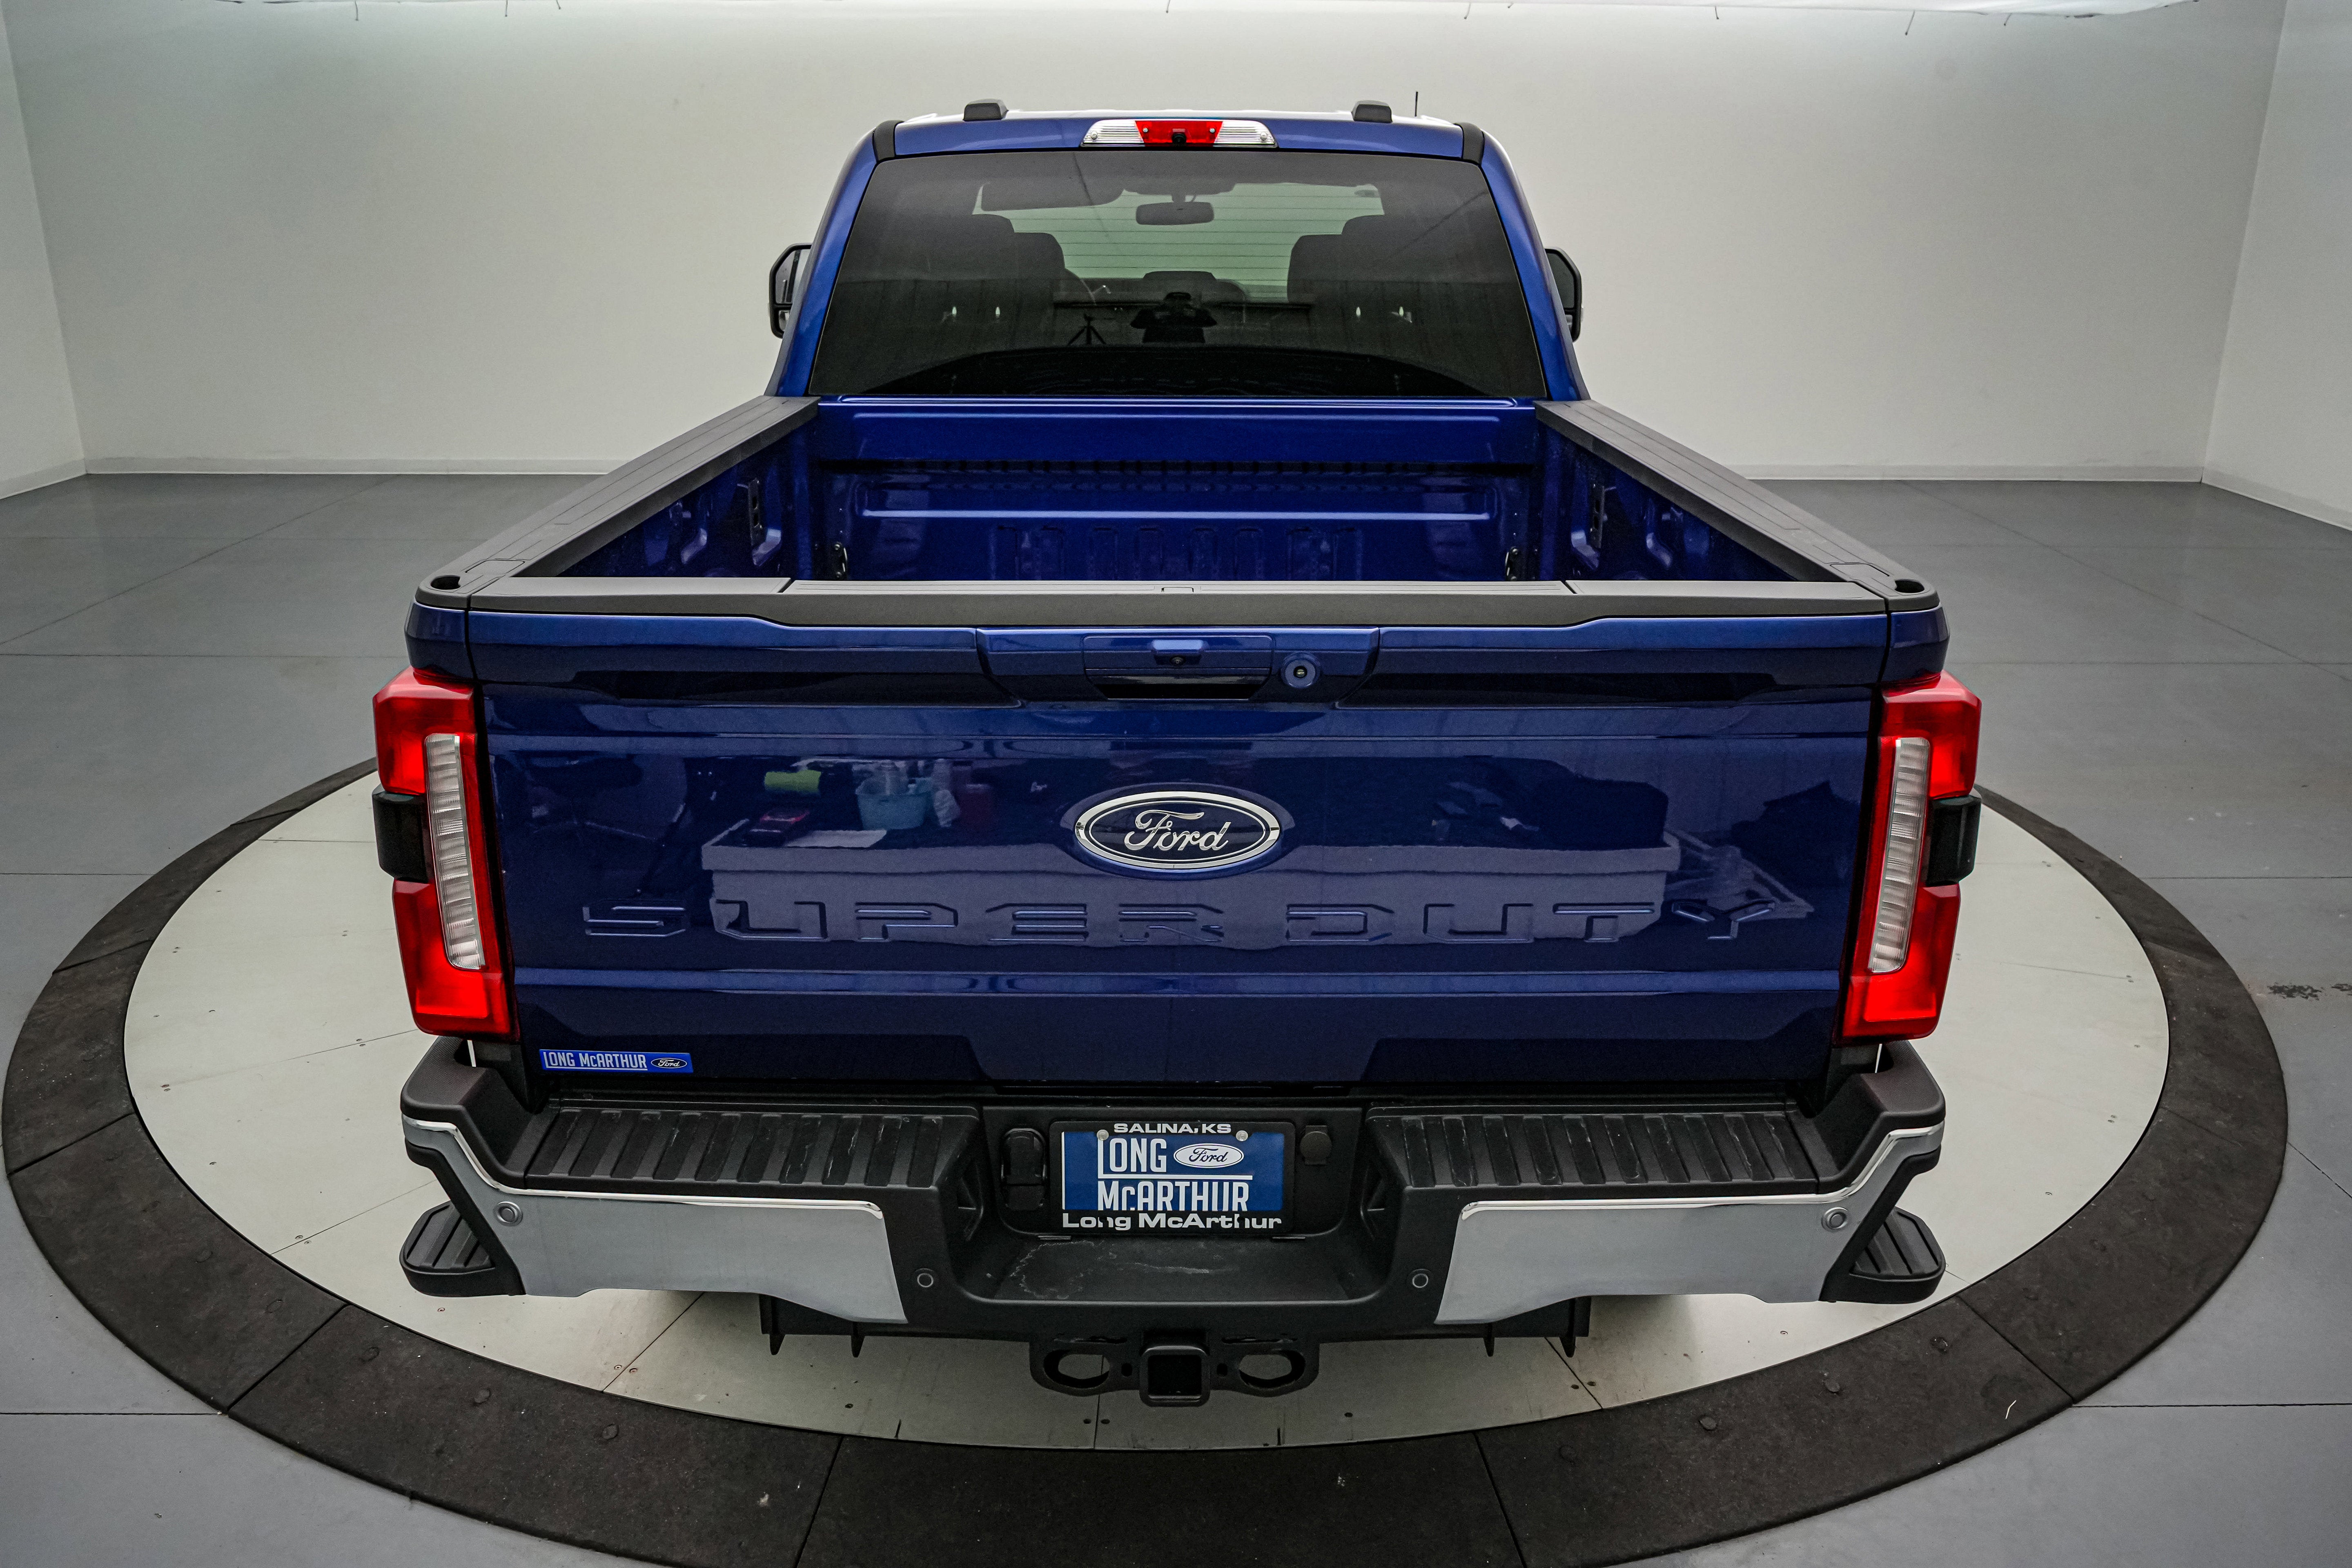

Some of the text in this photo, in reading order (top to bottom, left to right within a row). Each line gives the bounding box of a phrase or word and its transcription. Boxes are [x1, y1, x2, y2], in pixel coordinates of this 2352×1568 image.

[1124, 809, 1232, 851] Ford
[581, 901, 1775, 943] SUPER DUTY
[543, 1051, 647, 1068] LONG McARTHUR
[658, 1059, 680, 1067] Ford
[1114, 1123, 1231, 1134] SALINA, KS
[1098, 1138, 1167, 1179] LONG
[1189, 1147, 1229, 1163] Ford
[1098, 1181, 1249, 1211] McARTHUR
[1063, 1213, 1282, 1231] Long McArthur
